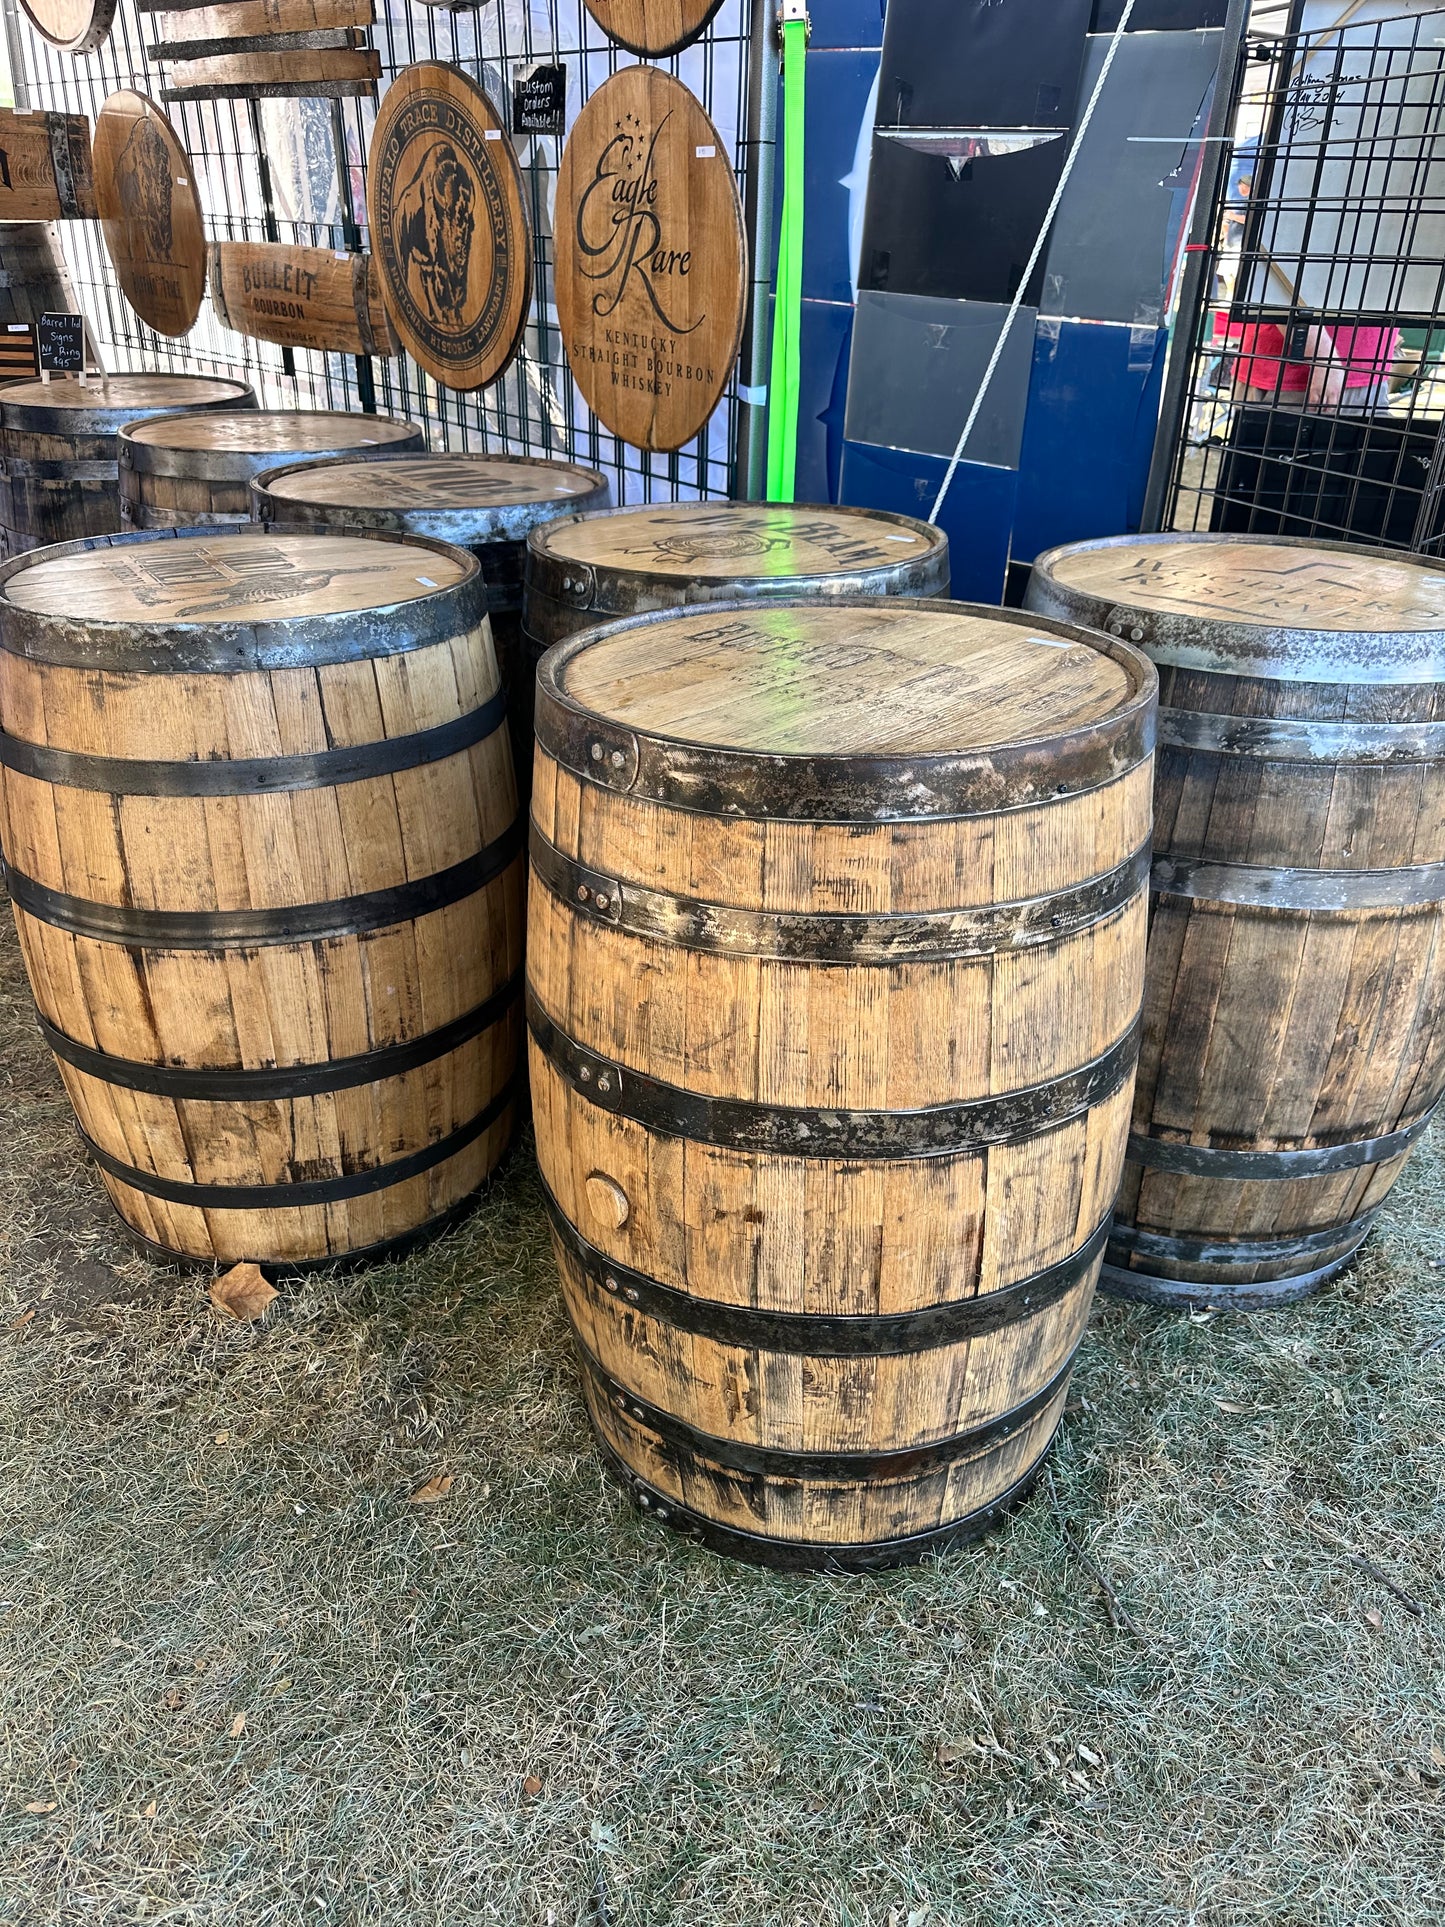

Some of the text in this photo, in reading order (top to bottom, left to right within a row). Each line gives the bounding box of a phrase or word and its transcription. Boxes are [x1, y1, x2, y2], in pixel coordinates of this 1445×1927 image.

[1313, 90, 1345, 104] 204
[381, 104, 507, 249] BUFFALO TRACE DISTILLERY
[577, 109, 673, 279] Eagle
[242, 260, 317, 301] BULLEIT
[593, 207, 706, 334] Rare
[253, 297, 305, 320] BOURBON
[391, 266, 427, 337] NATIONAL
[430, 334, 474, 354] HISTORIC
[475, 274, 505, 343] LANDMARK
[41, 315, 67, 328] Barrel
[50, 331, 74, 346] Signs
[605, 329, 676, 354] KENTUCKY
[53, 356, 71, 367] $95
[59, 346, 81, 360] Ring
[573, 344, 714, 384] STRAIGHT BOURBON
[611, 371, 672, 396] WHISKEY
[766, 520, 888, 565] BEAM
